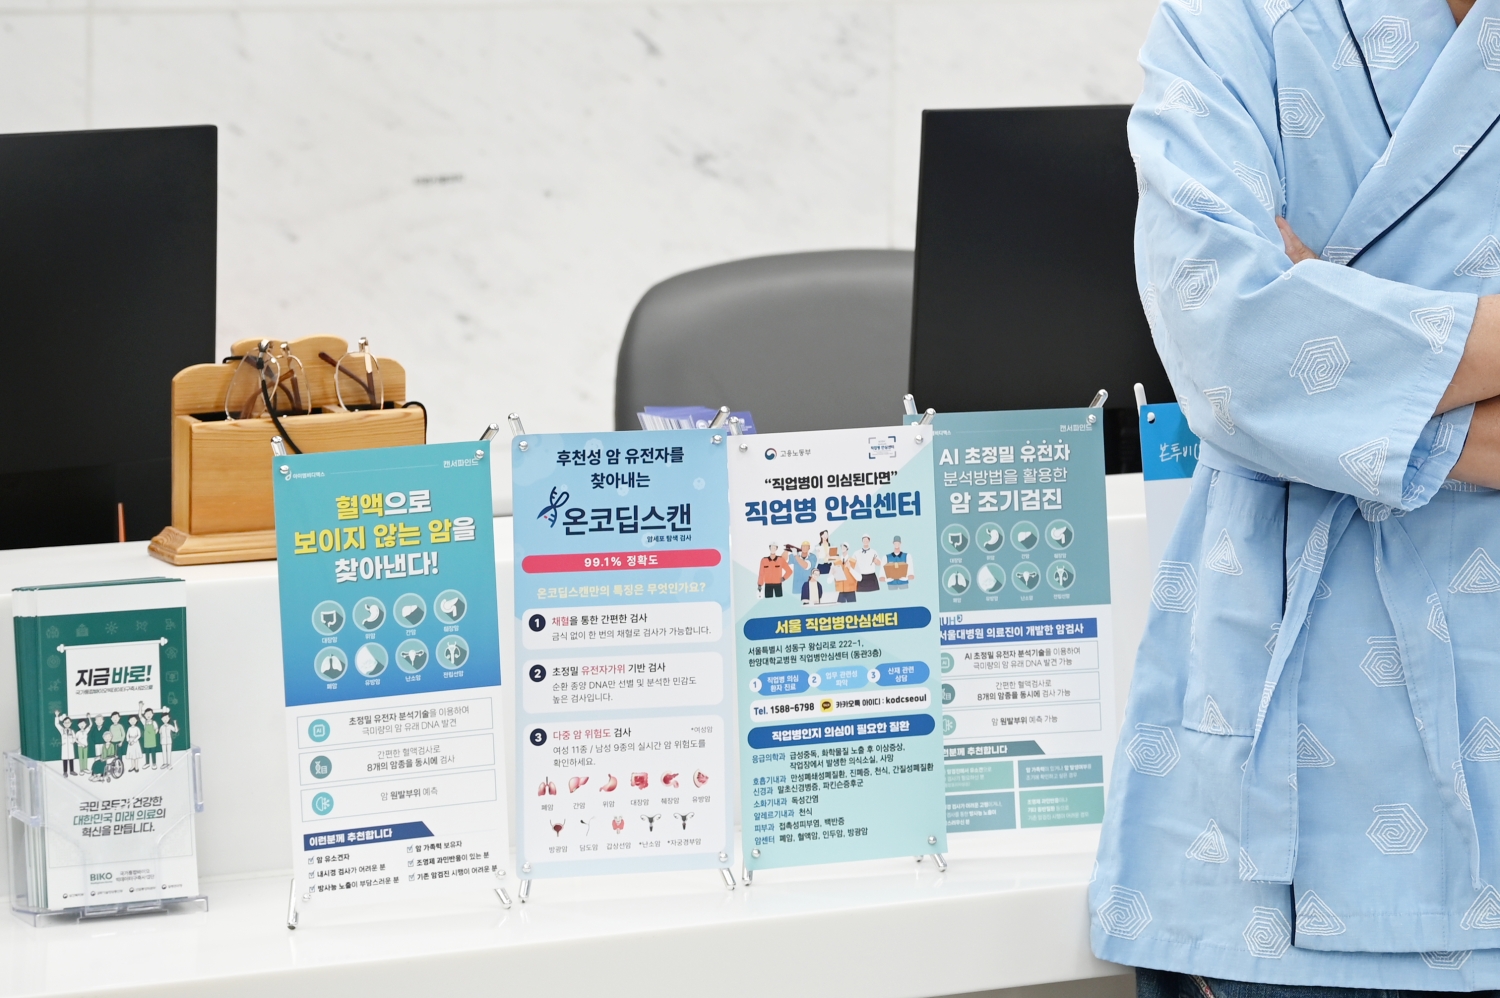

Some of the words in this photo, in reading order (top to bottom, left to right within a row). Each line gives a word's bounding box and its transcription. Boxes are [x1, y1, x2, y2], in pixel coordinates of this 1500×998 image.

[557, 449, 601, 466] 후천성
[606, 449, 620, 465] 암
[625, 447, 684, 464] 유전자를
[780, 448, 811, 458] 고용노동부
[939, 448, 959, 465] AI
[964, 446, 1015, 465] 초정밀
[1020, 439, 1070, 462] 유전자
[443, 458, 479, 468] 캔서파인드
[591, 472, 650, 489] 찾아내는
[943, 469, 1018, 487] 분석방법을
[1023, 467, 1067, 485] 활용한
[336, 489, 432, 520] 혈액으로
[745, 498, 817, 526] 직업병
[825, 490, 921, 522] 안심센터
[950, 492, 971, 514] 암
[978, 488, 1063, 513] 조기검진
[562, 503, 691, 536] 온코딥스캔
[294, 525, 366, 555] 보이지
[373, 522, 421, 548] 않는
[428, 516, 476, 544] 암을
[335, 552, 439, 584] 찾아낸다!
[584, 556, 621, 567] 99.1%
[627, 554, 658, 566] 정확도
[537, 585, 610, 599] 온코딥스캔만의
[613, 584, 645, 597] 특징은
[647, 582, 706, 594] 무엇인가요?
[534, 618, 540, 628] 1
[552, 615, 578, 626] 채혈을
[581, 615, 598, 625] 통한
[601, 614, 627, 624] 간편한
[630, 613, 647, 623] 검사
[775, 619, 802, 635] 서울
[806, 612, 898, 632] 직업병안심센터
[552, 632, 568, 641] 금식
[570, 631, 586, 640] 없이
[589, 631, 596, 639] 한
[599, 629, 614, 639] 번의
[617, 629, 641, 638] 채혈로
[643, 627, 667, 637] 검사가
[669, 626, 711, 636] 가능합니다.
[986, 627, 1023, 639] 의료진이
[1026, 625, 1053, 636] 개발한
[1056, 623, 1084, 635] 암검사
[748, 645, 782, 655] 서울특별시
[785, 644, 806, 653] 성동구
[808, 642, 836, 652] 왕십리로
[839, 640, 864, 649] 222-1,
[749, 655, 797, 667] 한양대학교병원
[800, 652, 848, 663] 직업병안심센터
[75, 668, 110, 686] 지금
[112, 665, 151, 684] 바로!
[534, 668, 541, 679] 2
[553, 665, 579, 677] 초정밀
[581, 664, 625, 675] 유전자가위
[628, 663, 646, 673] 기반
[648, 662, 666, 672] 검사
[553, 682, 568, 691] 순환
[571, 680, 586, 690] 종양
[589, 679, 616, 689] DNA만
[618, 679, 634, 688] 선별
[636, 678, 644, 688] 및
[646, 677, 670, 687] 분석한
[673, 676, 696, 686] 민감도
[553, 694, 568, 704] 높은
[571, 693, 613, 703] 검사입니다.
[754, 707, 768, 716] Tel.
[770, 703, 814, 714] 1588-6798
[836, 699, 860, 709] 카카오톡
[886, 694, 927, 704] kodcseoul
[349, 716, 371, 726] 초정밀
[374, 712, 396, 723] 유전자
[399, 709, 437, 721] 분석기술을
[439, 706, 469, 717] 이용하여
[362, 724, 393, 735] 극미량의
[395, 724, 403, 733] 암
[405, 722, 419, 732] 유래
[422, 721, 439, 730] DNA
[442, 719, 457, 728] 발견
[535, 732, 542, 742] 3
[553, 730, 570, 741] 다중
[573, 730, 582, 740] 암
[585, 729, 611, 739] 위험도
[614, 728, 631, 738] 검사
[772, 728, 822, 742] 직업병인지
[824, 725, 854, 738] 의심이
[857, 722, 887, 736] 필요한
[889, 720, 910, 732] 질환
[377, 748, 400, 760] 간편한
[402, 745, 441, 757] 혈액검사로
[367, 762, 388, 772] 8개의
[390, 759, 413, 771] 암종을
[415, 756, 438, 768] 동시에
[440, 754, 454, 764] 검사
[381, 791, 388, 801] 암
[390, 788, 421, 801] 원발부위
[423, 787, 438, 797] 예측
[80, 801, 99, 812] 국민
[133, 796, 162, 808] 건강한
[73, 813, 113, 826] 대한민국
[115, 811, 134, 822] 미래
[136, 808, 166, 820] 의료의
[82, 825, 111, 838] 혁신을
[114, 822, 155, 835] 만듭니다.
[309, 834, 345, 847] 이런분께
[347, 828, 392, 842] 추천합니다
[90, 872, 112, 881] BIKO
